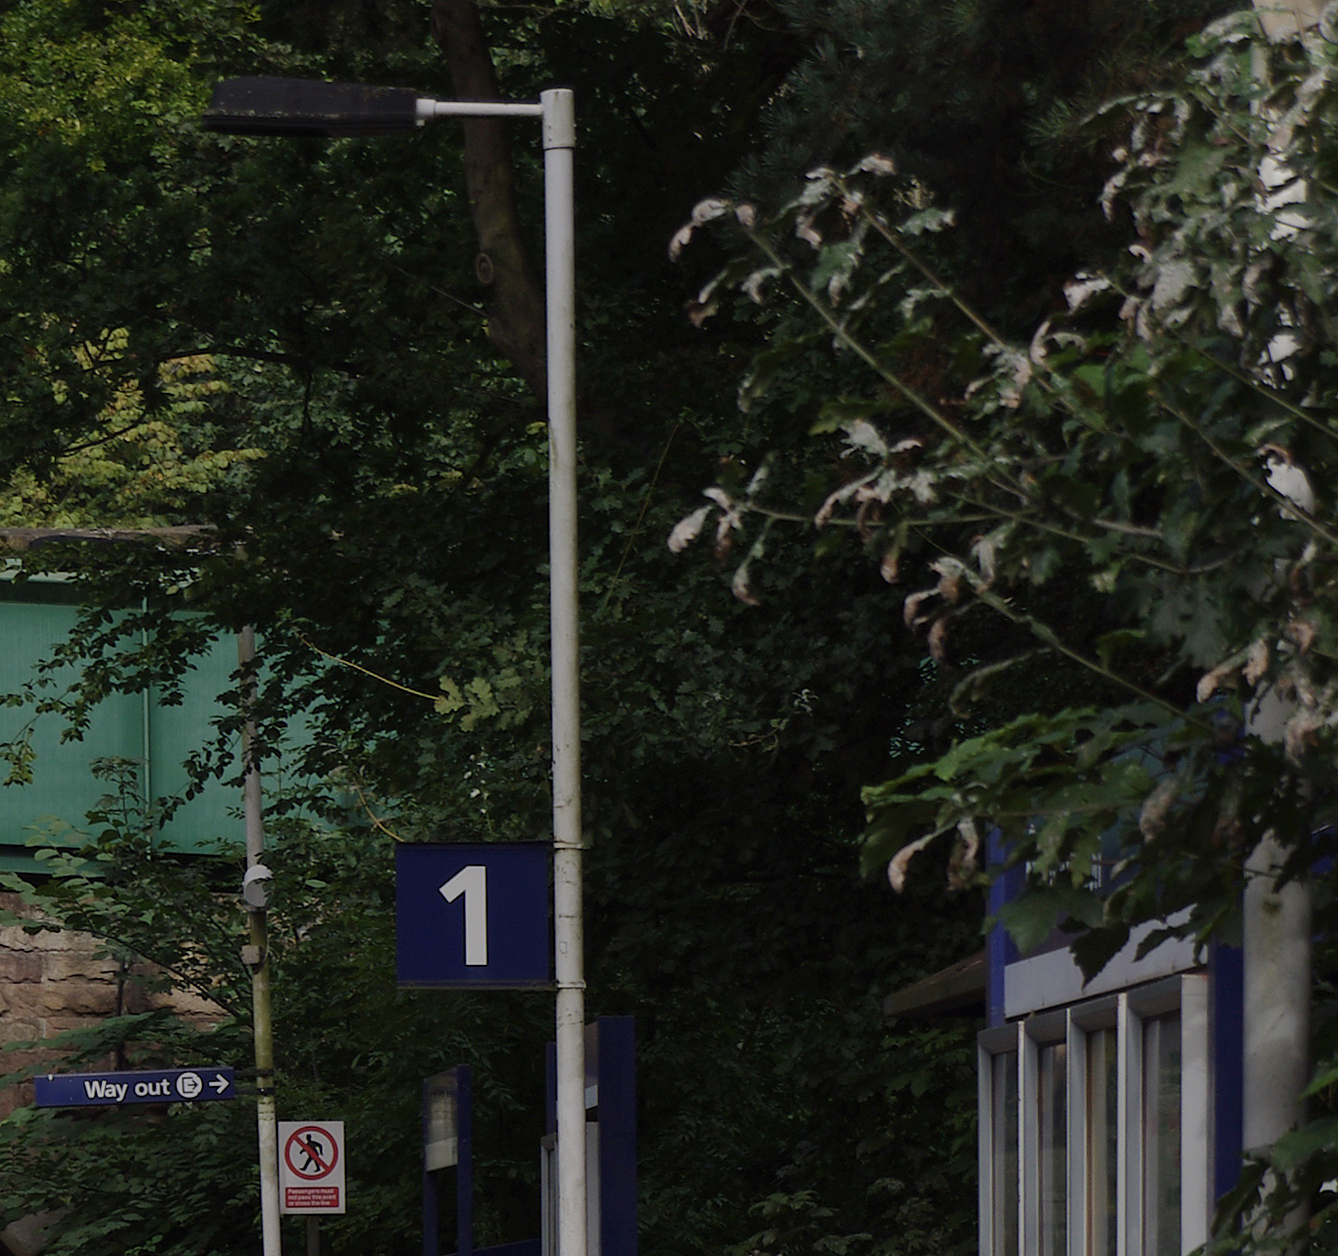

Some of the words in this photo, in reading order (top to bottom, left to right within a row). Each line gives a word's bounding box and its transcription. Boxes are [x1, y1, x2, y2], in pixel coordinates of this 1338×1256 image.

[438, 865, 488, 966] 1
[84, 1079, 128, 1102] Way
[134, 1078, 171, 1096] out
